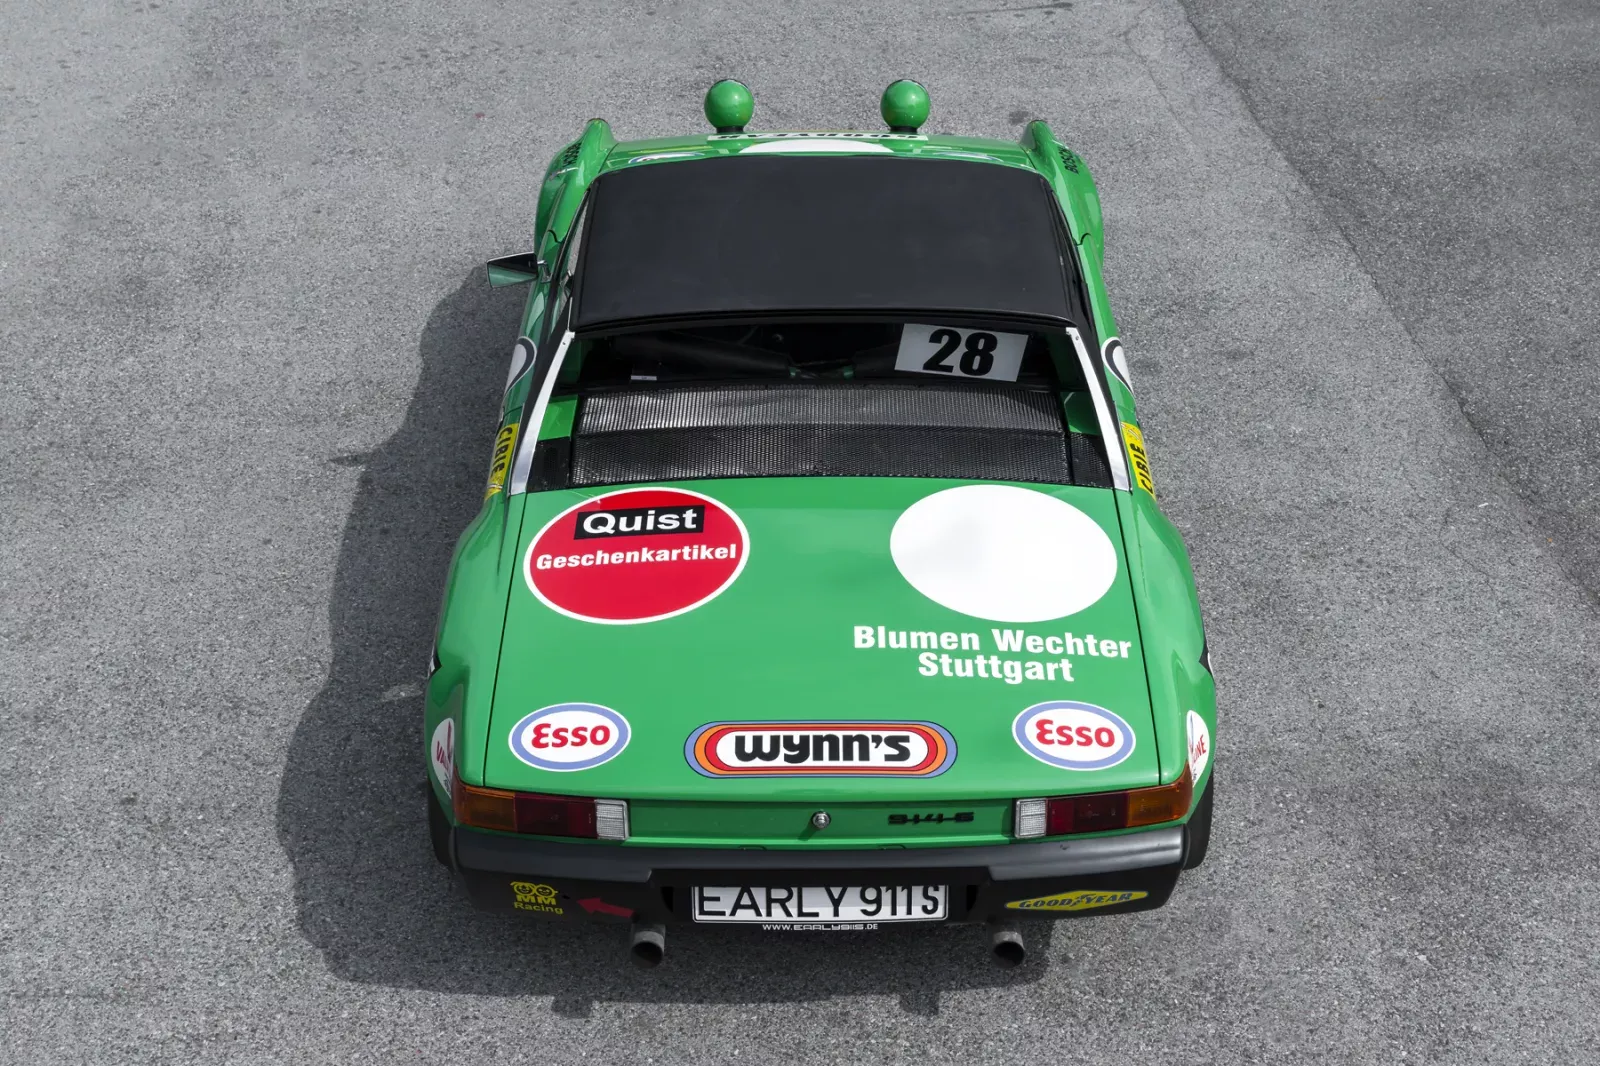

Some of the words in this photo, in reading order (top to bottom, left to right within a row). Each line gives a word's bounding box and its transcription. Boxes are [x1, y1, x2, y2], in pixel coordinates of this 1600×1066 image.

[922, 328, 998, 377] 28
[582, 508, 697, 535] Quist
[536, 543, 737, 570] Geschenkartikel
[853, 625, 981, 651] Blumen
[991, 628, 1132, 659] Wechter
[918, 651, 1075, 685] Stuttgart
[513, 901, 564, 916] Racing
[698, 886, 849, 918] EARLY
